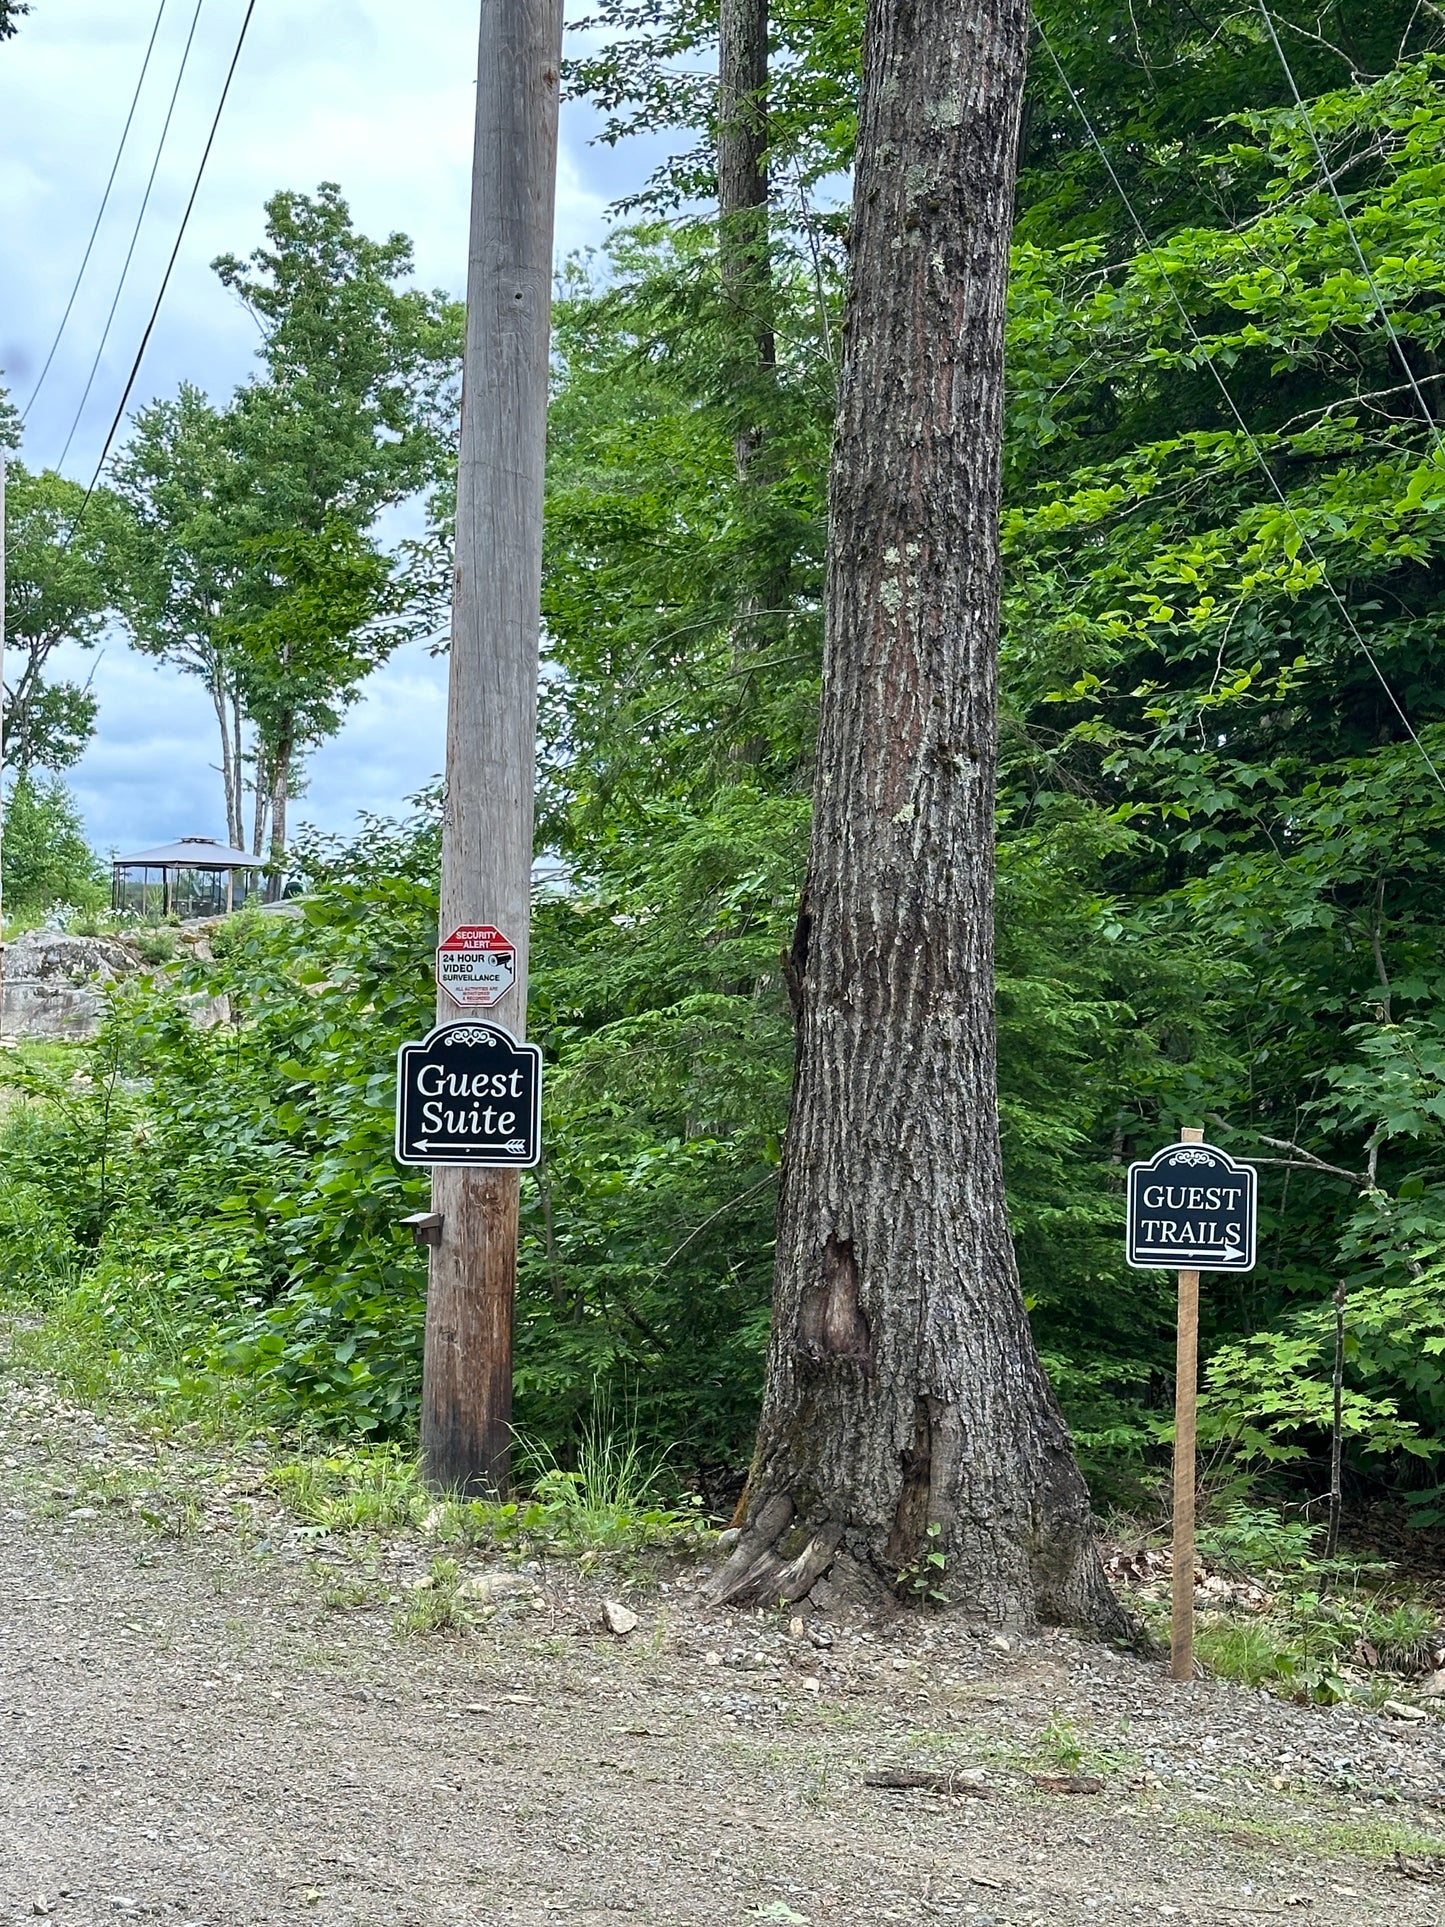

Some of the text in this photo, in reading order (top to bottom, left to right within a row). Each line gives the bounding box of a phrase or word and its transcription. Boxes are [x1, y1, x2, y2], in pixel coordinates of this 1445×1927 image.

[456, 931, 497, 939] SECURITY
[463, 940, 490, 948] ALERT
[442, 954, 484, 962] 24 HOUR
[443, 964, 473, 972] VIDEO
[416, 1064, 524, 1098] Guest
[421, 1101, 516, 1134] Suite
[1143, 1186, 1242, 1210] GUEST
[1141, 1220, 1240, 1246] TRAILS
